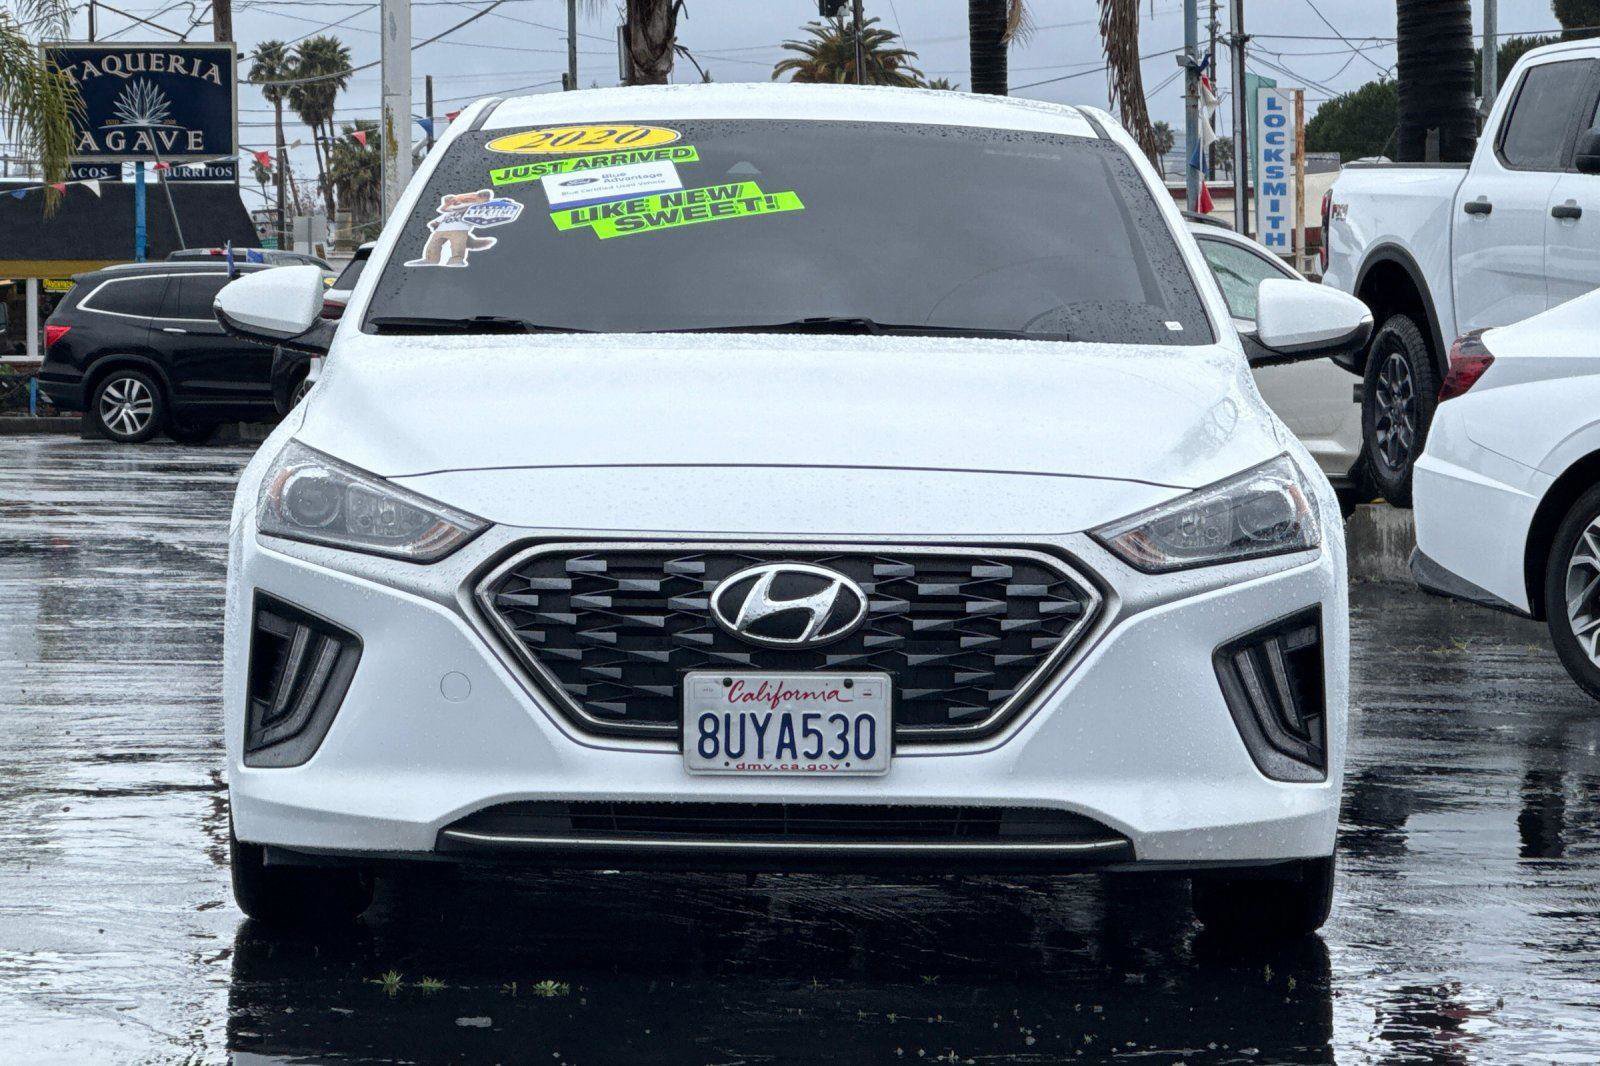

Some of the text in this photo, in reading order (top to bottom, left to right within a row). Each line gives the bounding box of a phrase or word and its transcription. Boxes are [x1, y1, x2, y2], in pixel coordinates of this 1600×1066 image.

[61, 52, 222, 86] TAQUERIA
[76, 130, 204, 151] AGAVE
[514, 125, 652, 151] 2020
[67, 166, 109, 179] ACOS
[164, 165, 233, 178] BURRITOS
[495, 147, 693, 180] JUST ARRIVED
[603, 173, 663, 183] Advantage
[1263, 97, 1287, 246] LOCKSMITH
[570, 184, 744, 225] LIKE NEW
[614, 194, 779, 232] SWEET!
[728, 680, 853, 710] California
[698, 712, 876, 760] 8UYA530
[736, 762, 840, 772] dmv.ca.gov
